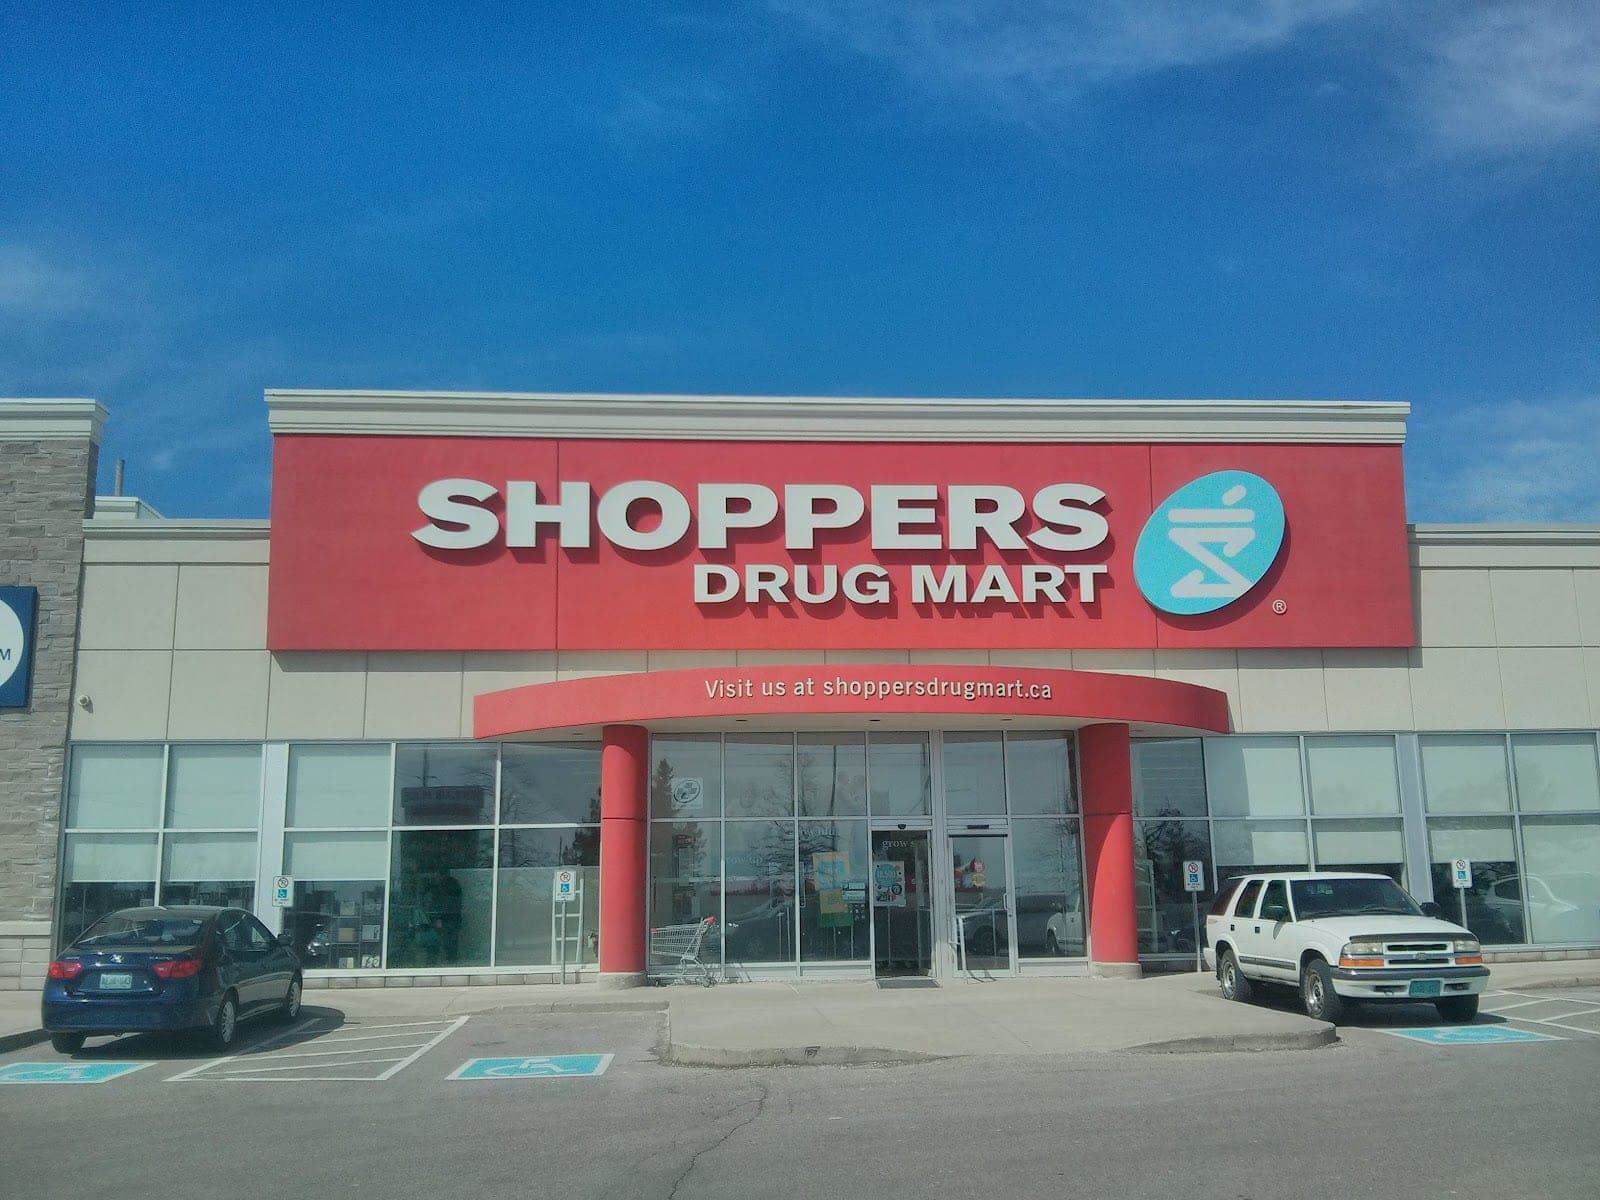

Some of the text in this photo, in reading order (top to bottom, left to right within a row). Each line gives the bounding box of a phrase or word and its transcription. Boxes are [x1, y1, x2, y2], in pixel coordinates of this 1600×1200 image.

[410, 477, 1109, 552] SHOPPERS
[693, 563, 1108, 604] DRUG MART
[704, 676, 1052, 700] Visit us at shoppersdrugmart.ca
